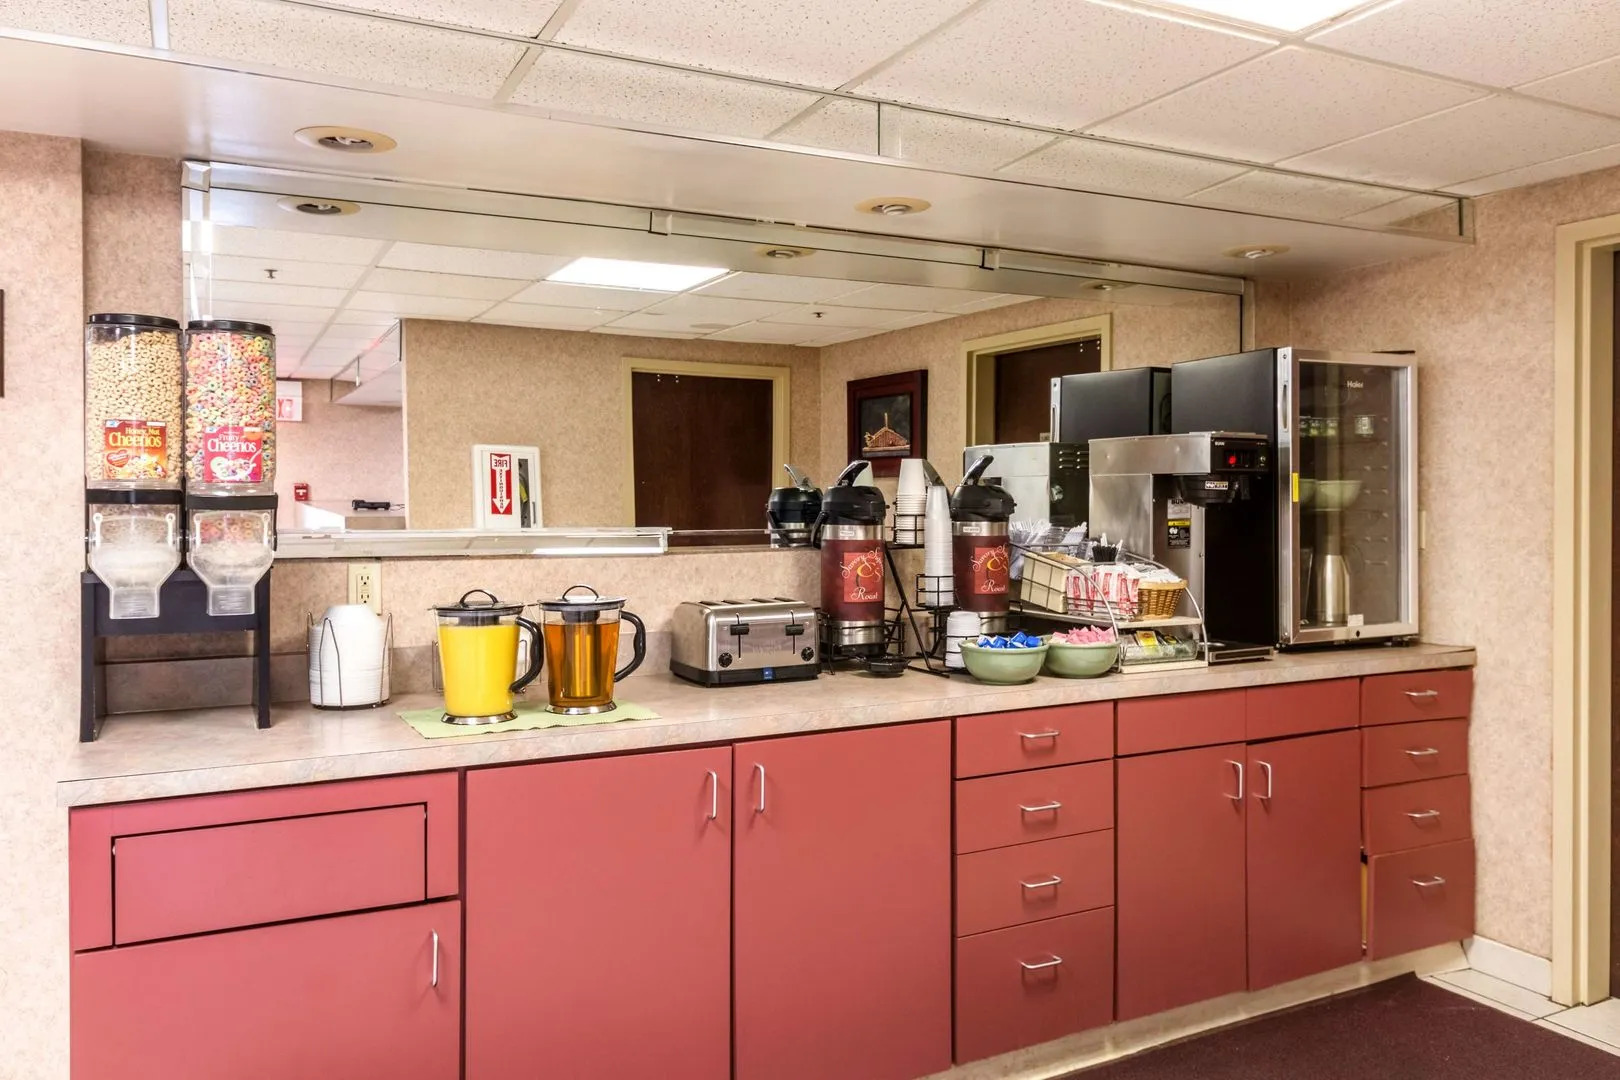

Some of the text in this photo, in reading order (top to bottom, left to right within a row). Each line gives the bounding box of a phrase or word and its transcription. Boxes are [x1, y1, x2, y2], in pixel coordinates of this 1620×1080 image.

[125, 427, 148, 437] Honey
[108, 432, 162, 448] Cheerios
[207, 438, 257, 453] Cheerios
